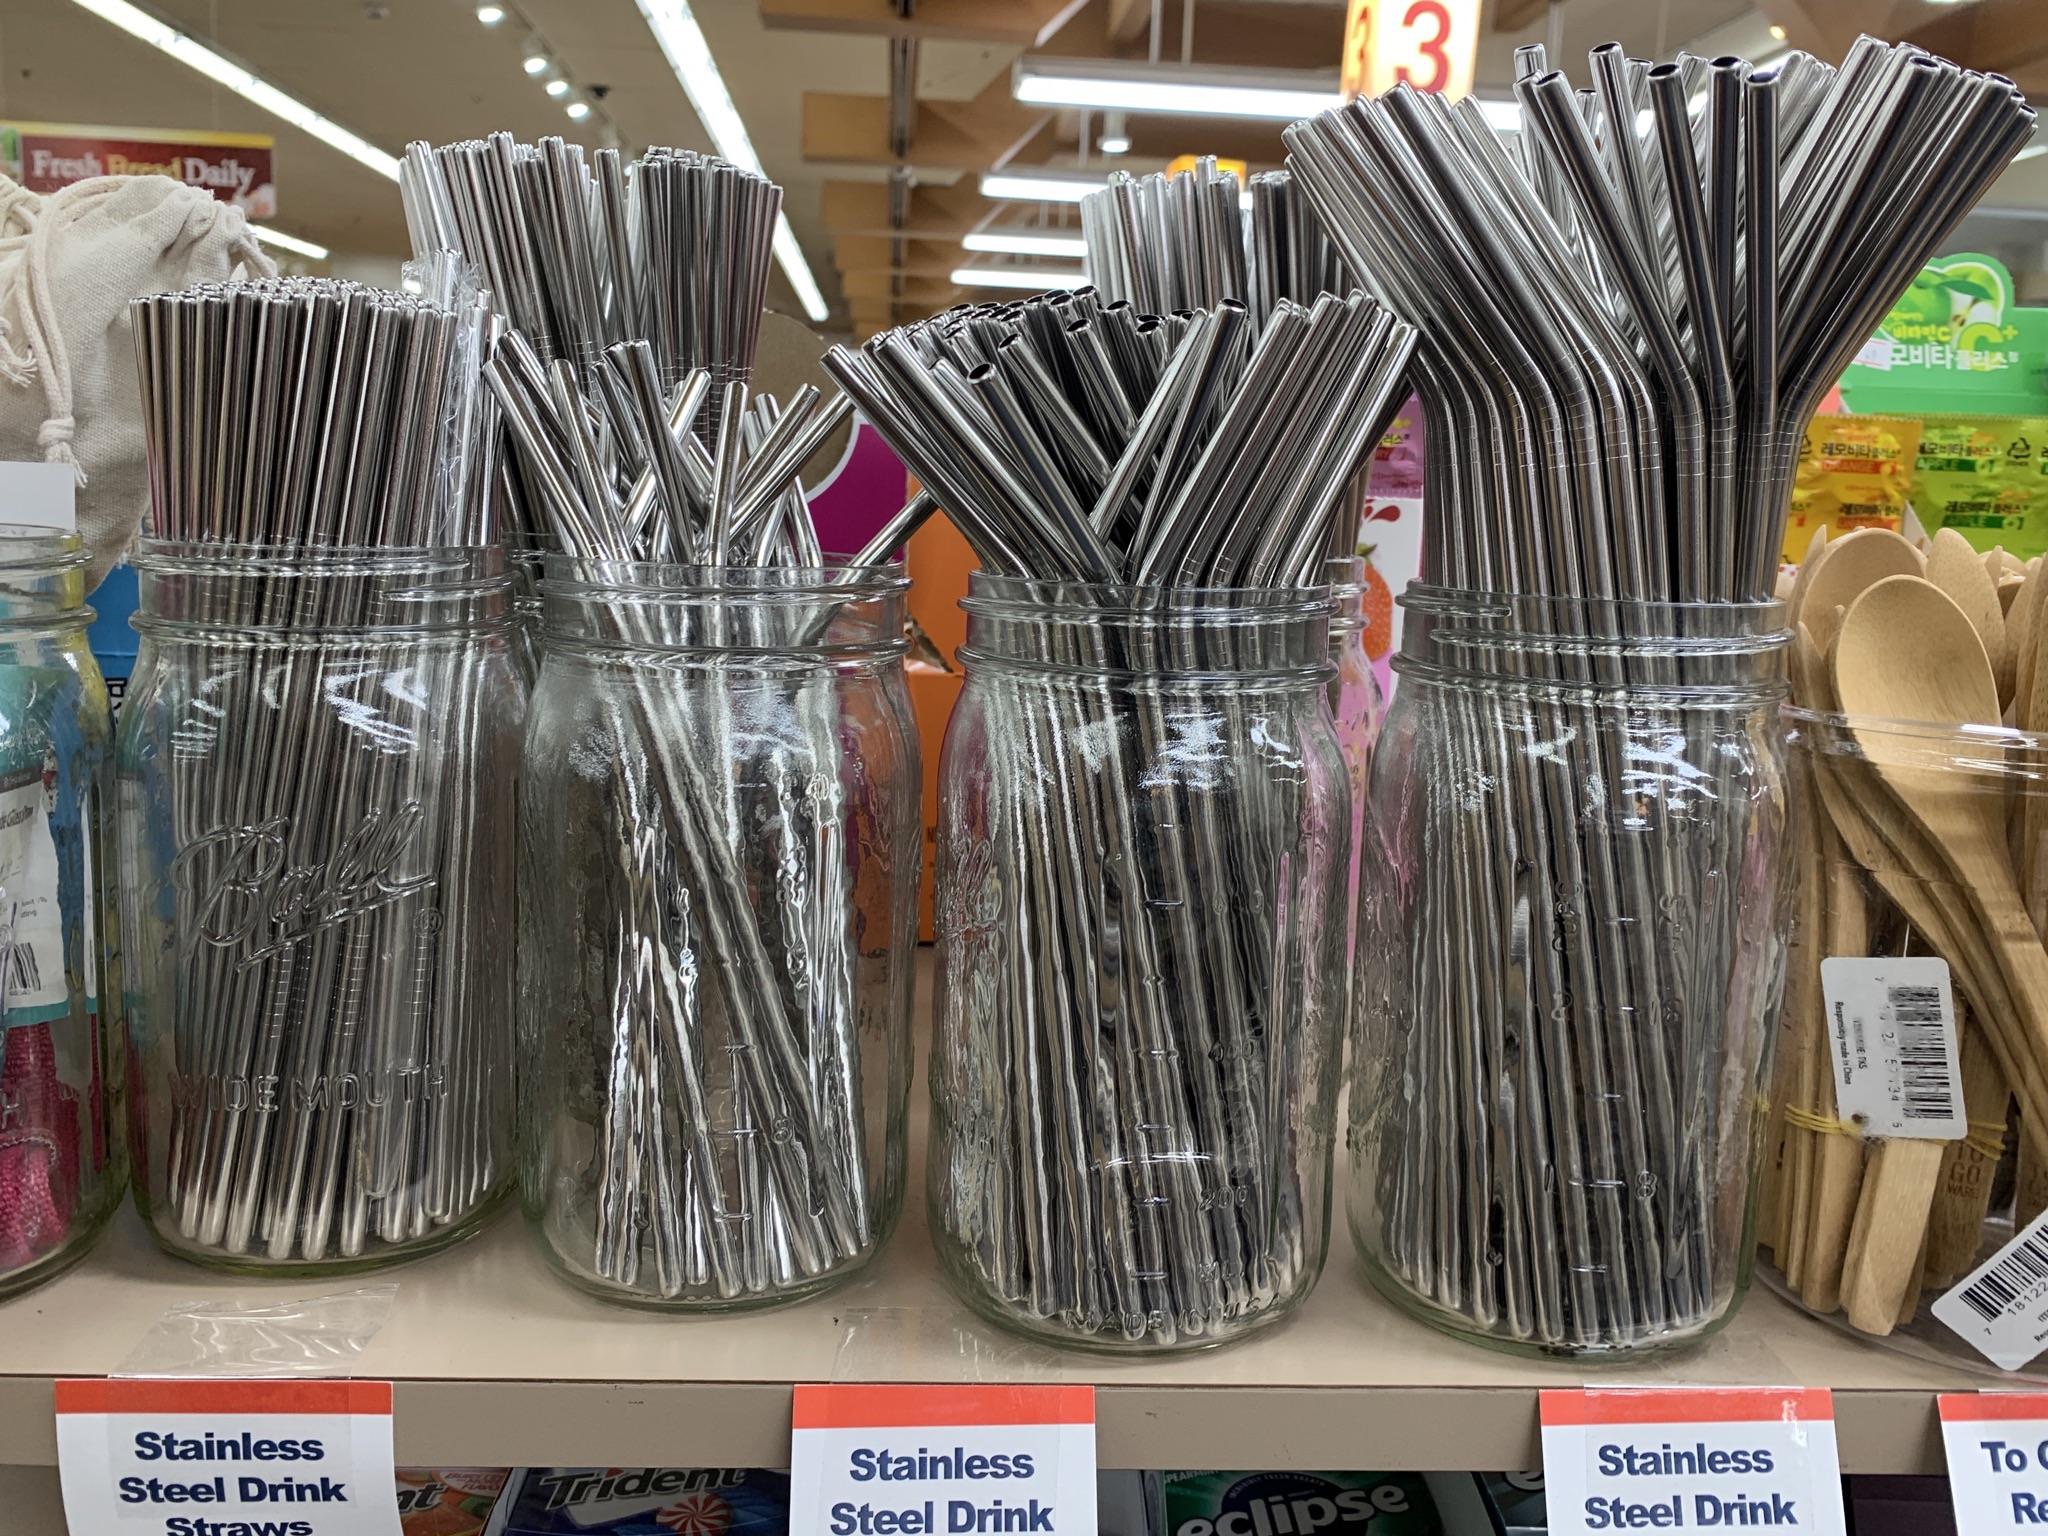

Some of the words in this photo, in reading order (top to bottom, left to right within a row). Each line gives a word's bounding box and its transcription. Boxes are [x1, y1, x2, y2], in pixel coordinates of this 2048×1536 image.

[1394, 0, 1452, 95] 3
[31, 150, 102, 179] Fresh
[184, 157, 256, 197] Daily
[170, 798, 437, 972] Ball
[170, 1071, 279, 1113] WIDE
[290, 1063, 450, 1113] MOUTH
[1950, 1160, 1982, 1185] GO
[134, 1431, 325, 1461] Stainless
[849, 1447, 1035, 1482] Stainless
[1598, 1442, 1775, 1477] Stainless
[1979, 1440, 2028, 1473] To
[118, 1476, 227, 1504] Steel
[238, 1476, 349, 1503] Drink
[540, 1468, 747, 1511] Trident
[165, 1517, 314, 1536] Straws
[829, 1500, 934, 1536] Steel
[947, 1499, 1055, 1534] Drink
[1176, 1484, 1411, 1536] eclipse
[1584, 1494, 1684, 1530] Steel
[1694, 1492, 1799, 1527] Drink
